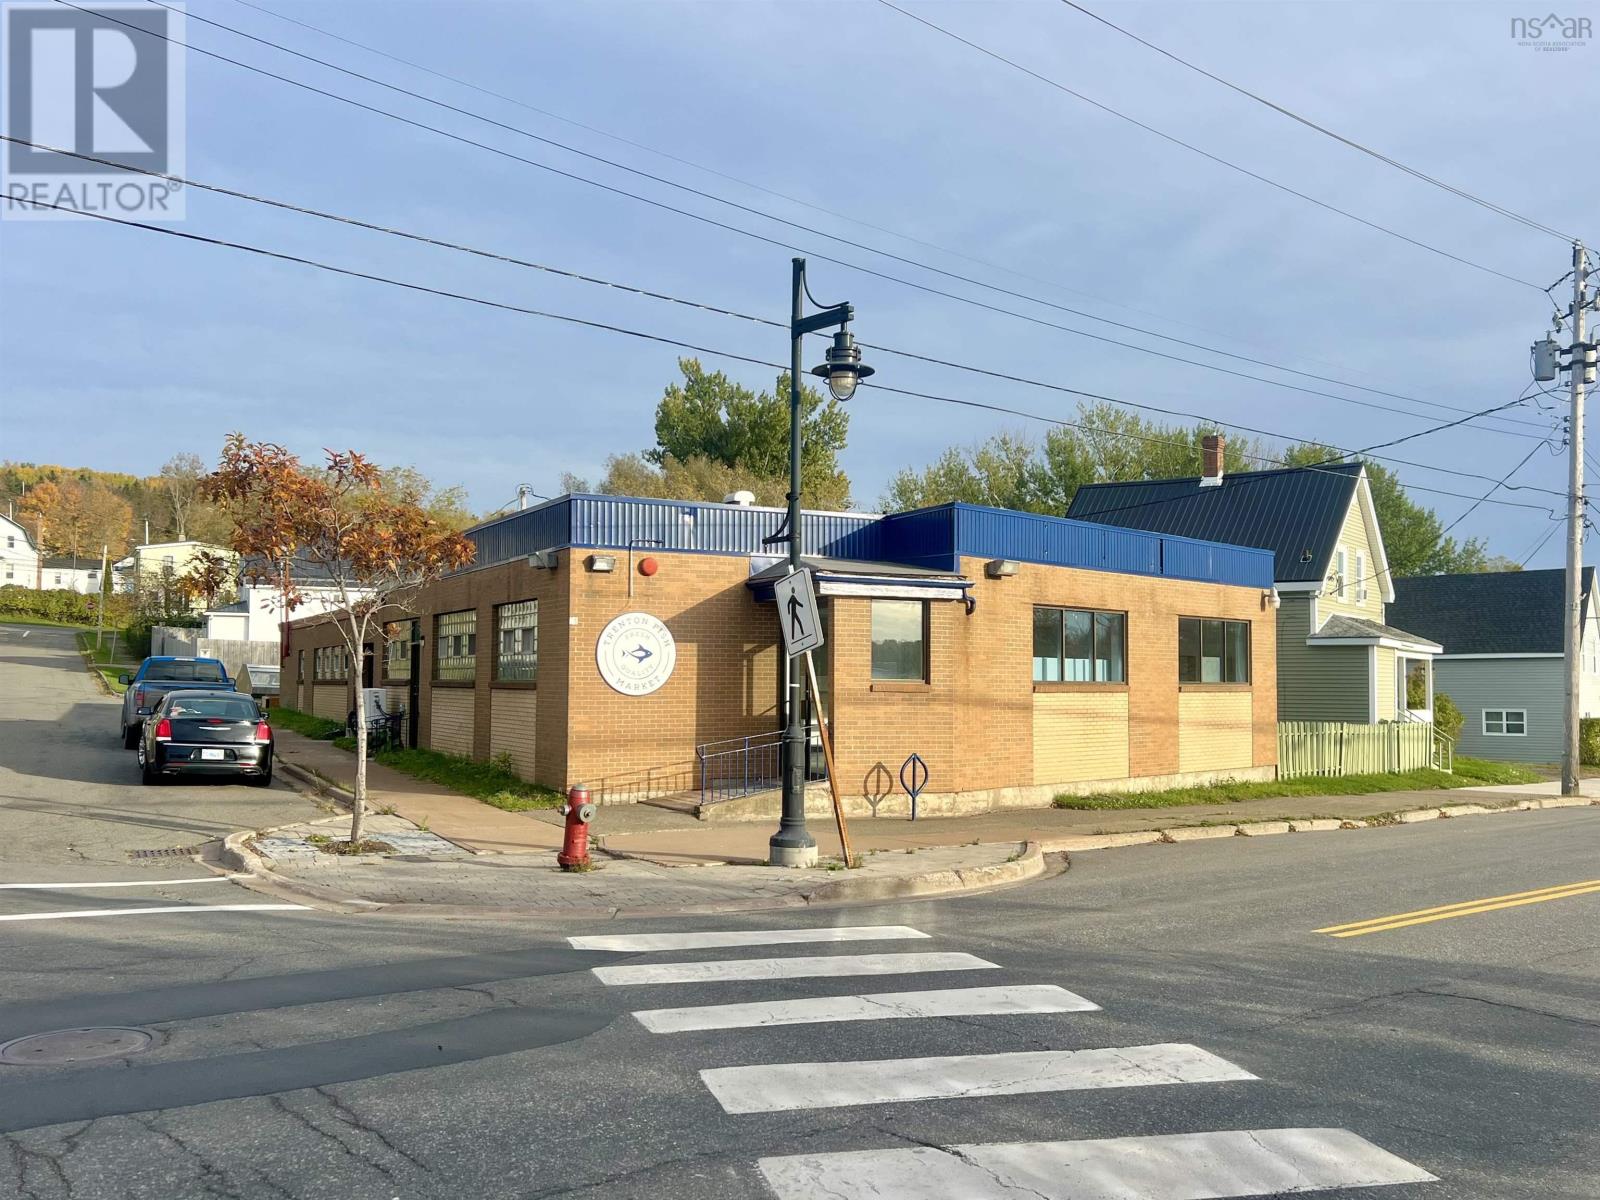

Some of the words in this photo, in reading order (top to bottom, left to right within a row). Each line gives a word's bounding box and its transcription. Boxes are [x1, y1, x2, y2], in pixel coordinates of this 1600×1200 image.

[603, 616, 649, 645] TRENTON
[652, 623, 671, 647] FISH
[616, 675, 661, 691] MARKET
